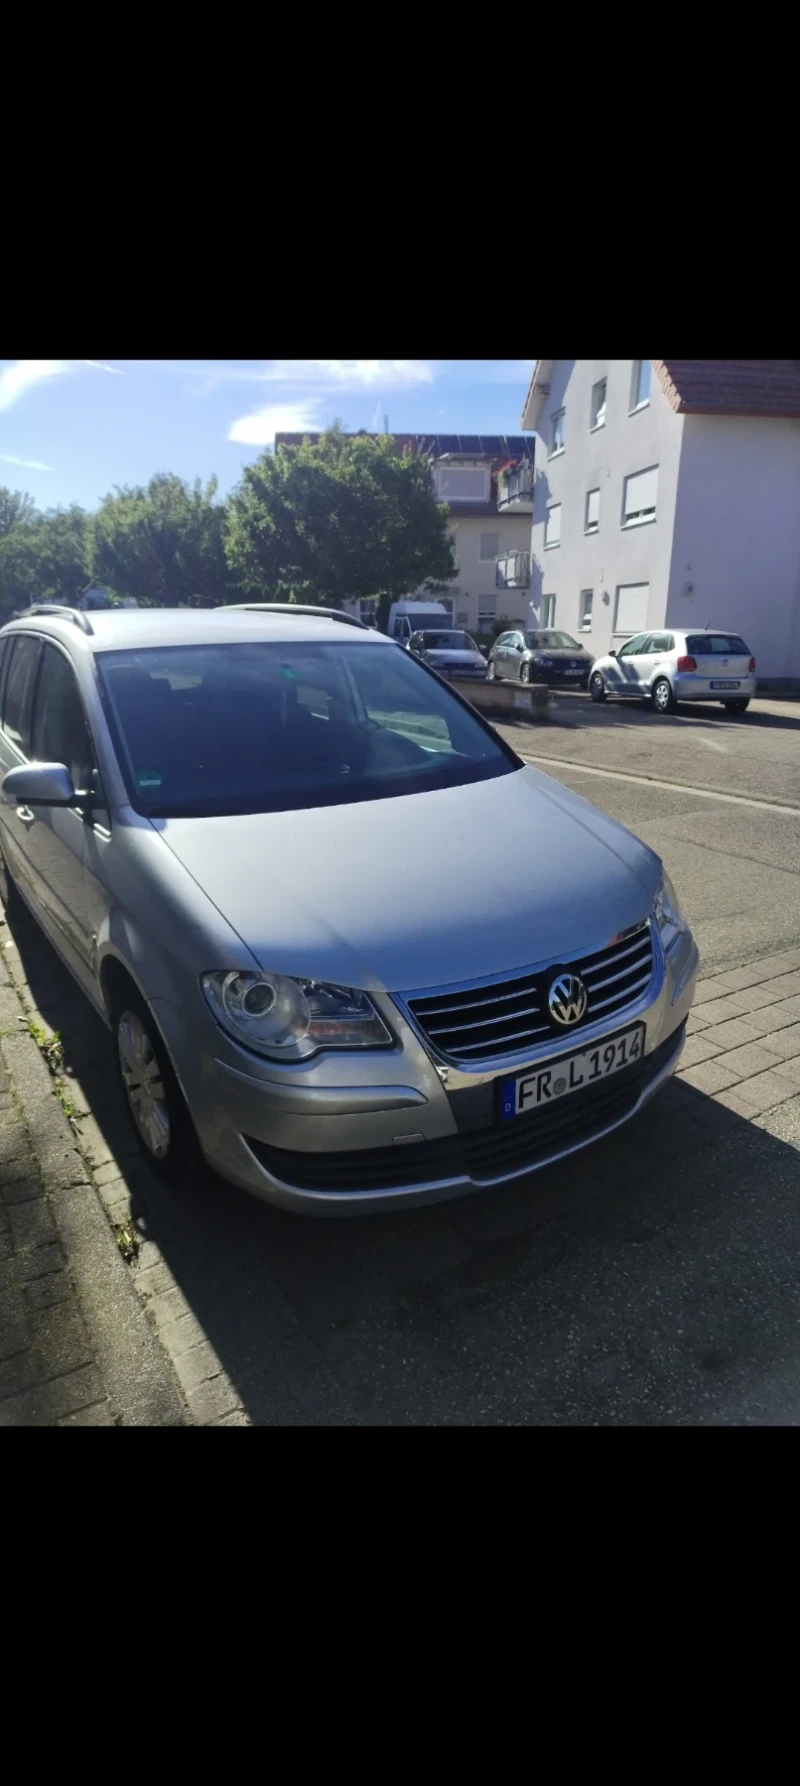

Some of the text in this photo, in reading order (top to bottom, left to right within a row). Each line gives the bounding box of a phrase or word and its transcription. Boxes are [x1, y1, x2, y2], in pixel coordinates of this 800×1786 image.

[549, 973, 587, 1025] VW
[518, 1031, 640, 1109] FR L 1914
